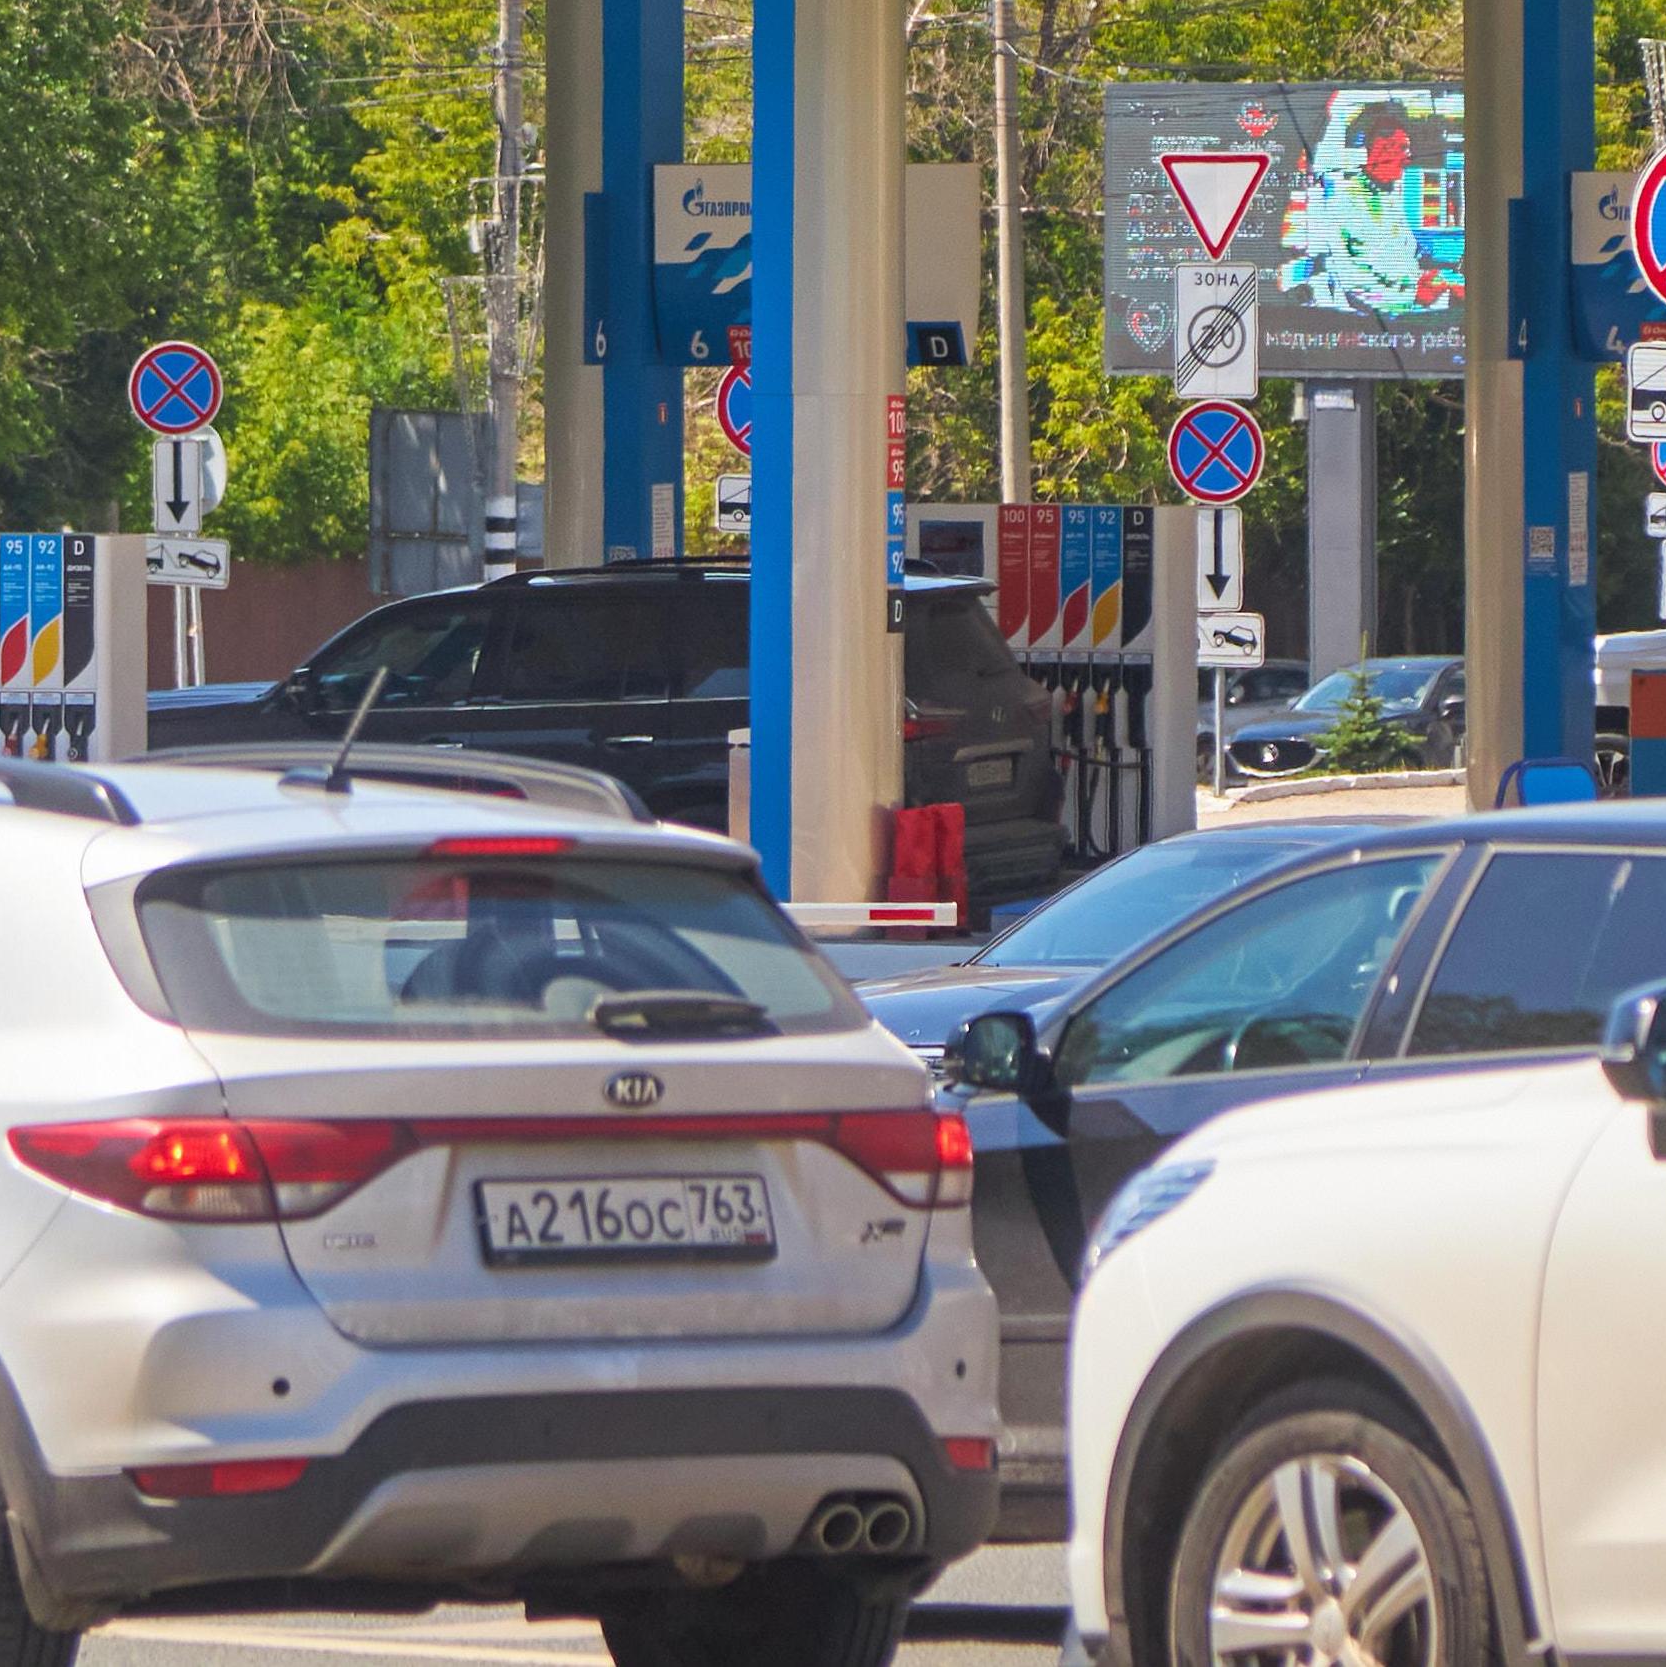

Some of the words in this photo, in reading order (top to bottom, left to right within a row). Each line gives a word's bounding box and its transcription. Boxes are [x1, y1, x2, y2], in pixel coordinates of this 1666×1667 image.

[1194, 272, 1240, 286] ЗОНА
[595, 319, 607, 358] 6
[1517, 317, 1528, 352] 4
[691, 330, 710, 359] 6
[931, 336, 949, 358] D
[1004, 509, 1025, 523] 100
[1037, 509, 1054, 523] 95
[1068, 510, 1086, 524] 95
[1099, 510, 1116, 525] 92
[1133, 511, 1144, 525] D
[6, 540, 23, 555] 95
[38, 540, 56, 555] 92
[74, 540, 85, 556] D
[894, 599, 903, 622] D
[616, 1077, 658, 1102] KIA
[507, 1187, 683, 1244] А216ОС
[688, 1184, 756, 1224] 763
